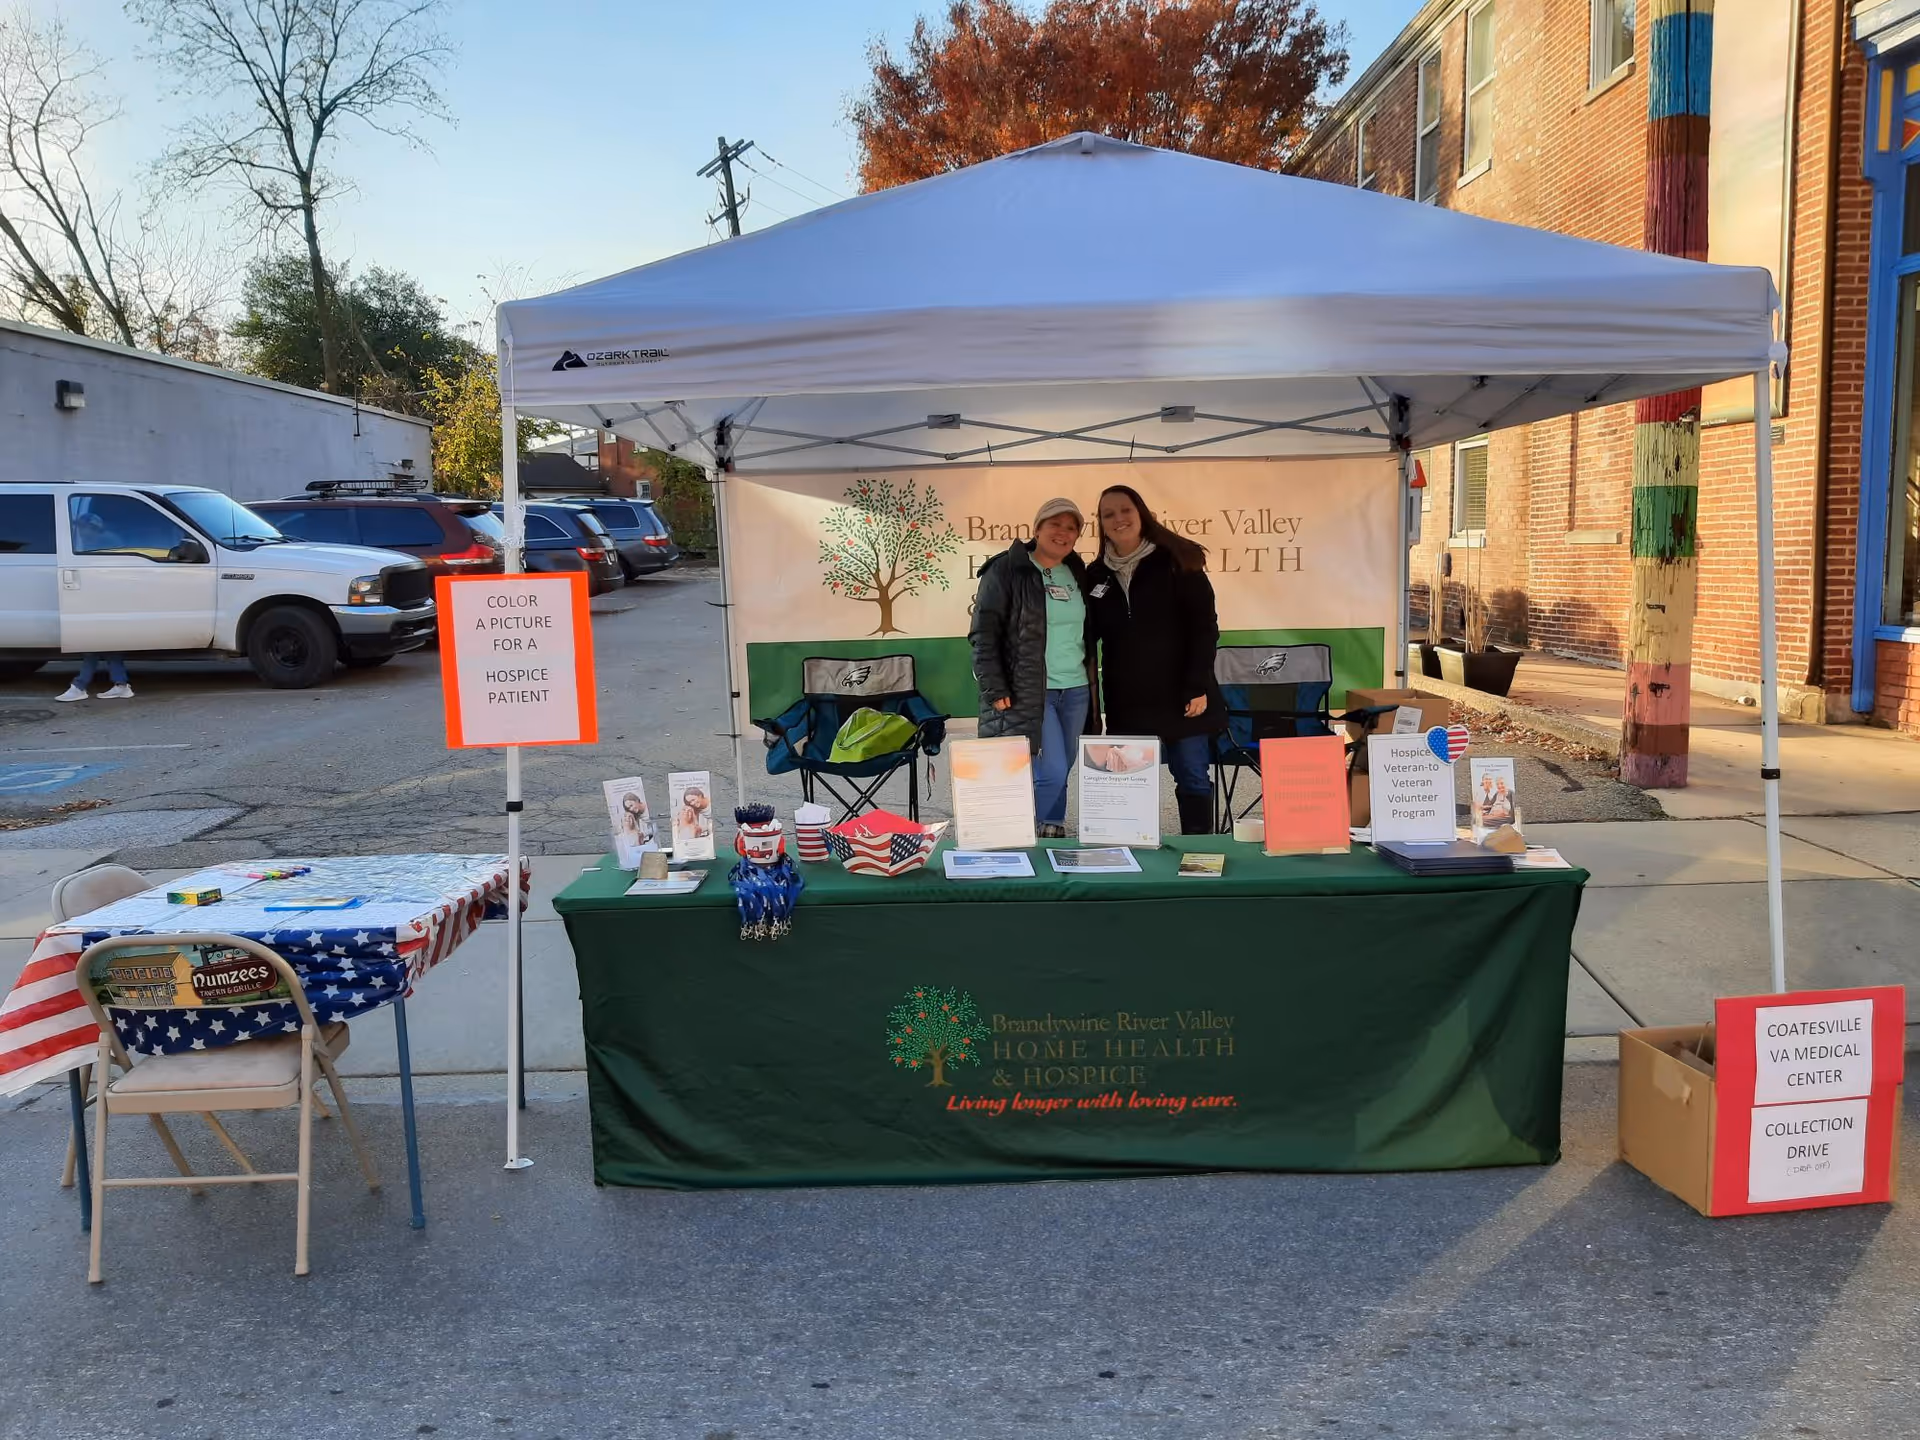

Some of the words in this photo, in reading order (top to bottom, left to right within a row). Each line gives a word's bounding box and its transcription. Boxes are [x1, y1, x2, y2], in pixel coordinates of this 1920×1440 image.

[1161, 510, 1213, 536] iver
[1219, 508, 1303, 542] Valley
[487, 595, 538, 609] COLOR
[475, 617, 486, 630] A
[490, 616, 552, 630] PICTURE
[493, 638, 523, 651] FOR
[527, 637, 538, 650] A
[486, 668, 549, 683] HOSPICE
[488, 689, 550, 704] PATIENT
[1391, 747, 1431, 759] Hospice
[1384, 762, 1439, 774] Veteran-to
[1391, 778, 1432, 788] Veteran
[1387, 794, 1439, 804] Volunteer
[1392, 808, 1435, 820] Program
[200, 988, 226, 997] TAVERN
[233, 981, 262, 993] GRILLE
[991, 1013, 1110, 1037] Brandywine
[1117, 1012, 1169, 1033] River
[1175, 1010, 1235, 1035] Valley
[1767, 1017, 1862, 1037] COATESVILLE
[993, 1040, 1088, 1060] HOME
[1105, 1037, 1235, 1057] HEALTH
[1769, 1048, 1790, 1063] VA
[1794, 1043, 1861, 1061] MEDICAL
[992, 1068, 1014, 1087] &
[1024, 1065, 1147, 1088] HOSPICE
[1787, 1069, 1843, 1087] CENTER
[946, 1094, 1006, 1116] Living
[1011, 1092, 1073, 1117] longer
[1077, 1090, 1123, 1110] with
[1128, 1090, 1186, 1114] loving
[1191, 1093, 1238, 1108] care.
[1765, 1116, 1853, 1137] COLLECTION
[1786, 1142, 1829, 1159] DRIVE
